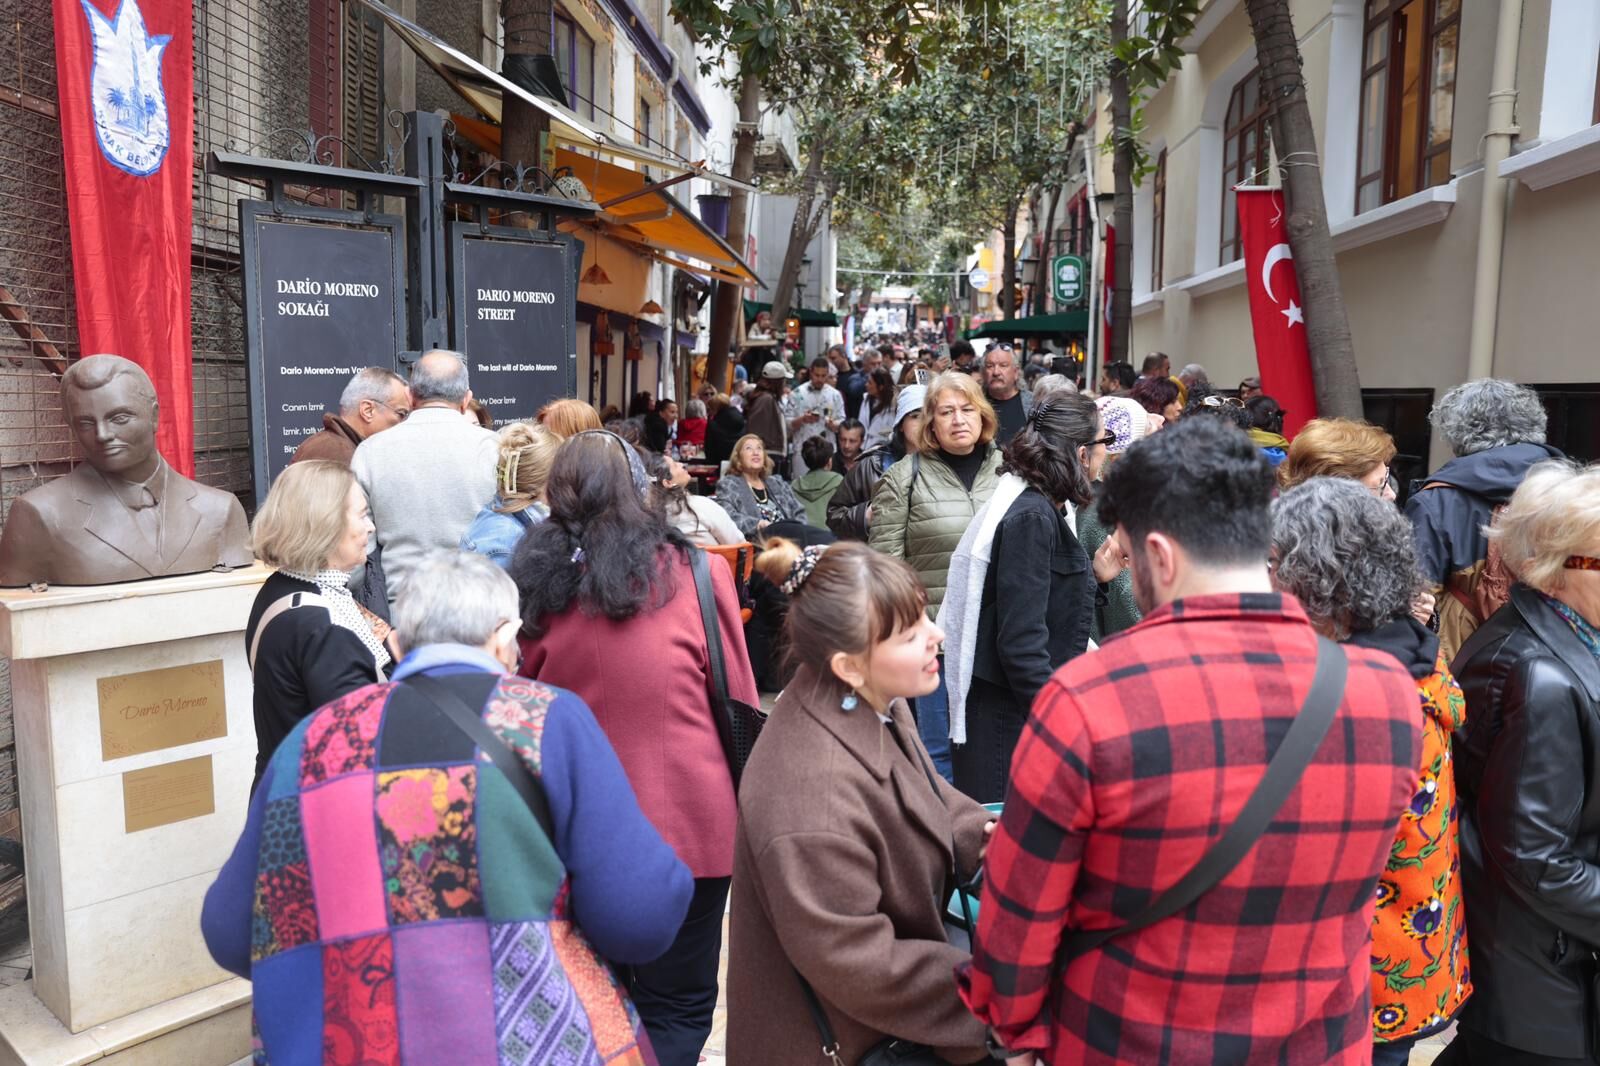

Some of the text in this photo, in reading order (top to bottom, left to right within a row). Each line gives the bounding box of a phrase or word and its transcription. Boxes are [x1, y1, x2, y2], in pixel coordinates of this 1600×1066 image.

[277, 277, 379, 298] DARİO MORENO
[477, 288, 555, 304] DARIO MORENO
[278, 300, 330, 317] SOKAĞI
[477, 307, 516, 321] STREET
[280, 366, 303, 375] Dario
[478, 364, 489, 372] The
[490, 363, 501, 372] last
[512, 363, 519, 371] of
[519, 363, 535, 371] Dario
[162, 697, 208, 717] Moreno
